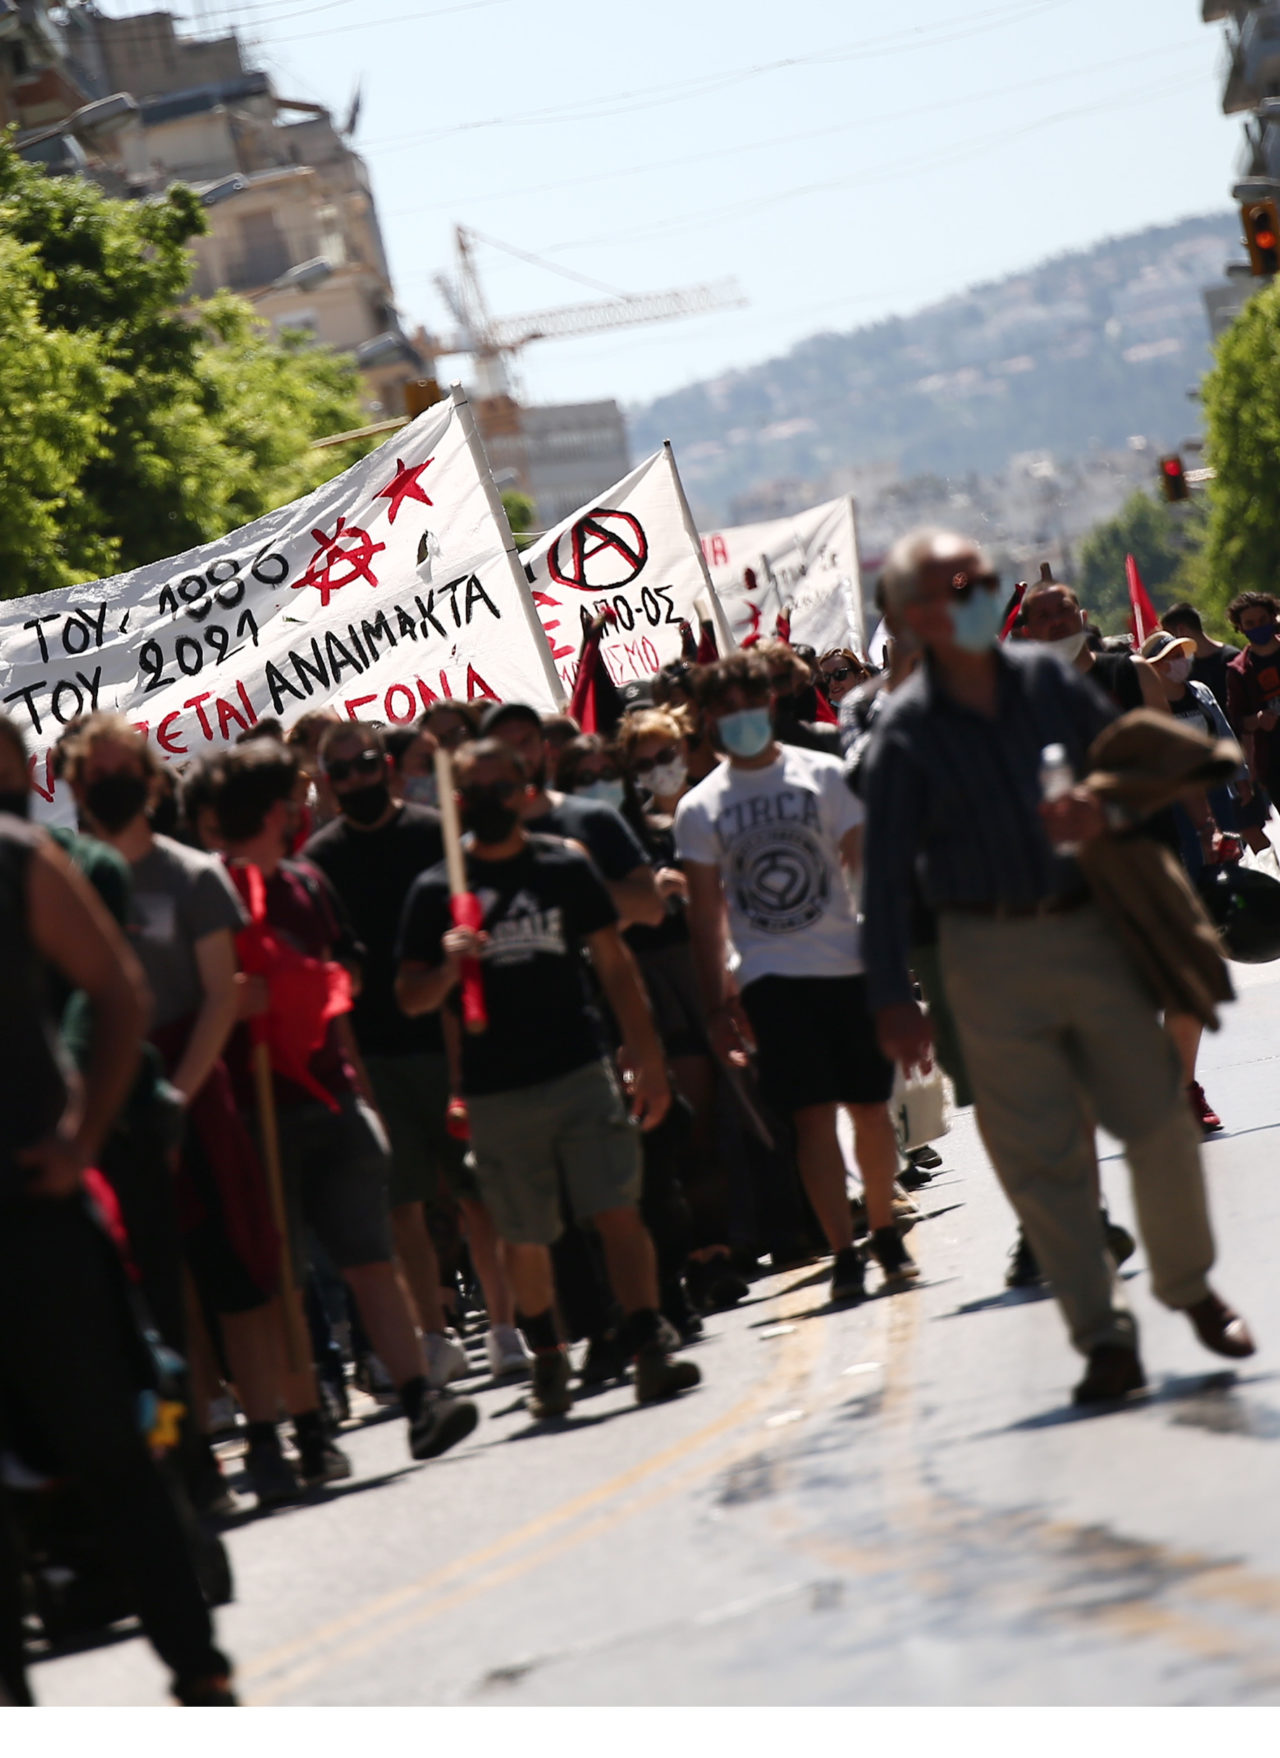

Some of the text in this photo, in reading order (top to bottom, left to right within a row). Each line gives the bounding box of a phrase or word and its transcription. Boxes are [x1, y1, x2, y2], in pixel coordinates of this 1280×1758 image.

[3, 666, 102, 735] ΤΟΥ
[139, 609, 259, 693] 2021
[24, 602, 107, 663] ΤΟΥ
[129, 680, 258, 754] ΕΤΑΙ
[265, 573, 501, 716] ΑΝΑΙΜΑΚΤΑ
